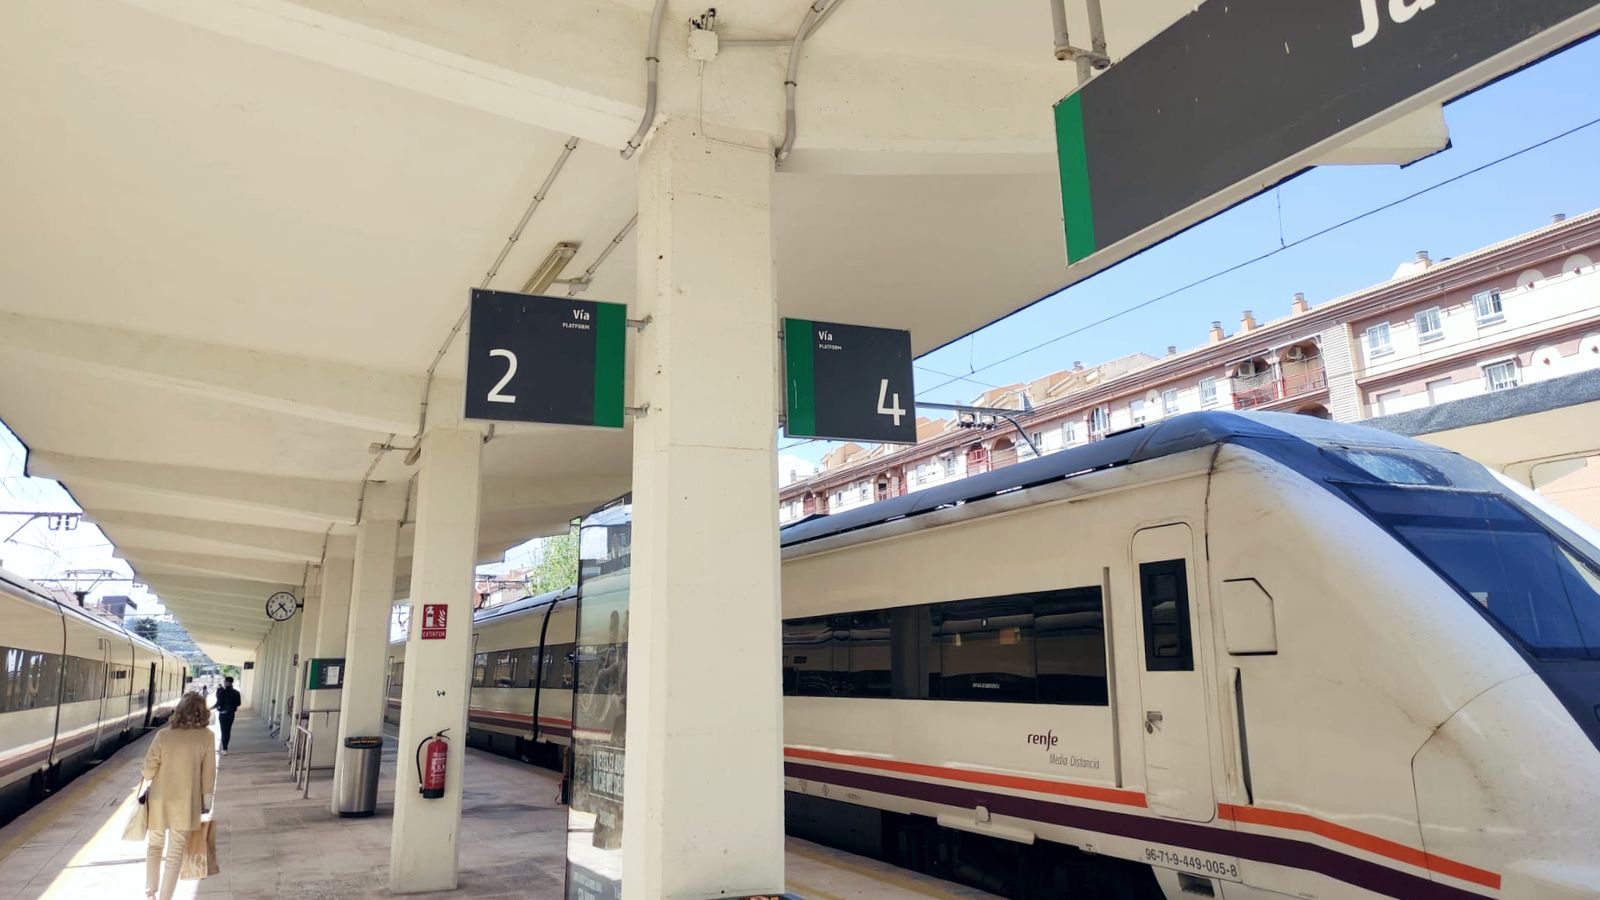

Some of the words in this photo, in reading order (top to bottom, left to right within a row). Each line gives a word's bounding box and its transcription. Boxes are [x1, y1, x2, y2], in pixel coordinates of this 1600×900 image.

[572, 309, 591, 321] Vía
[562, 322, 590, 330] PLATFORM
[818, 330, 833, 341] Vía
[487, 348, 518, 403] 2
[877, 378, 906, 426] 4
[1027, 729, 1058, 752] renfe
[1049, 753, 1068, 766] Media
[1070, 755, 1100, 769] Distancia
[1145, 848, 1238, 877] 96-71-9-449-005-8
